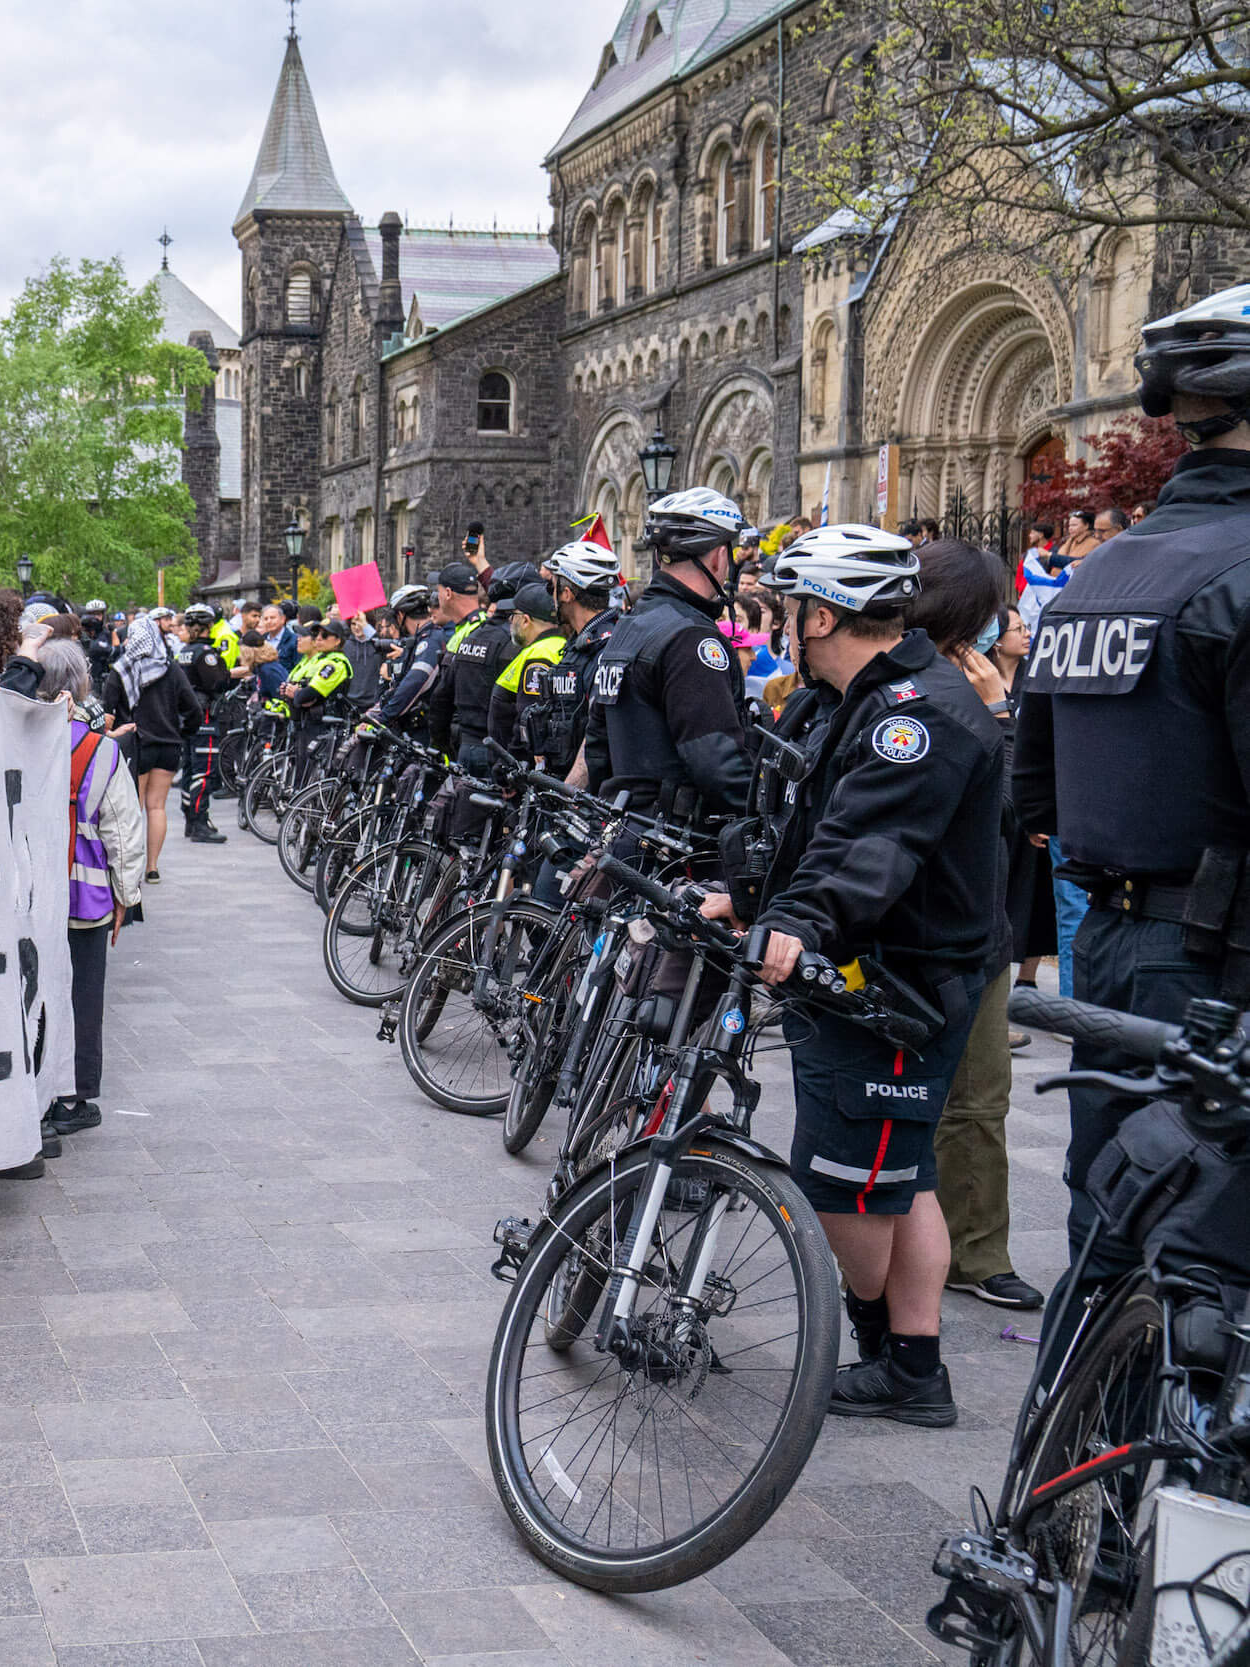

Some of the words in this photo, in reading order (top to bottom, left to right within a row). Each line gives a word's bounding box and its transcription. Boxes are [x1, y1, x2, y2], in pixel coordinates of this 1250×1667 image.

[803, 578, 857, 607] POLICE
[457, 643, 487, 658] POLICE
[1028, 617, 1159, 678] POLICE
[552, 676, 576, 694] POLICE
[886, 720, 923, 735] TORONTO
[883, 746, 911, 759] POLICE
[865, 1082, 928, 1101] POLICE
